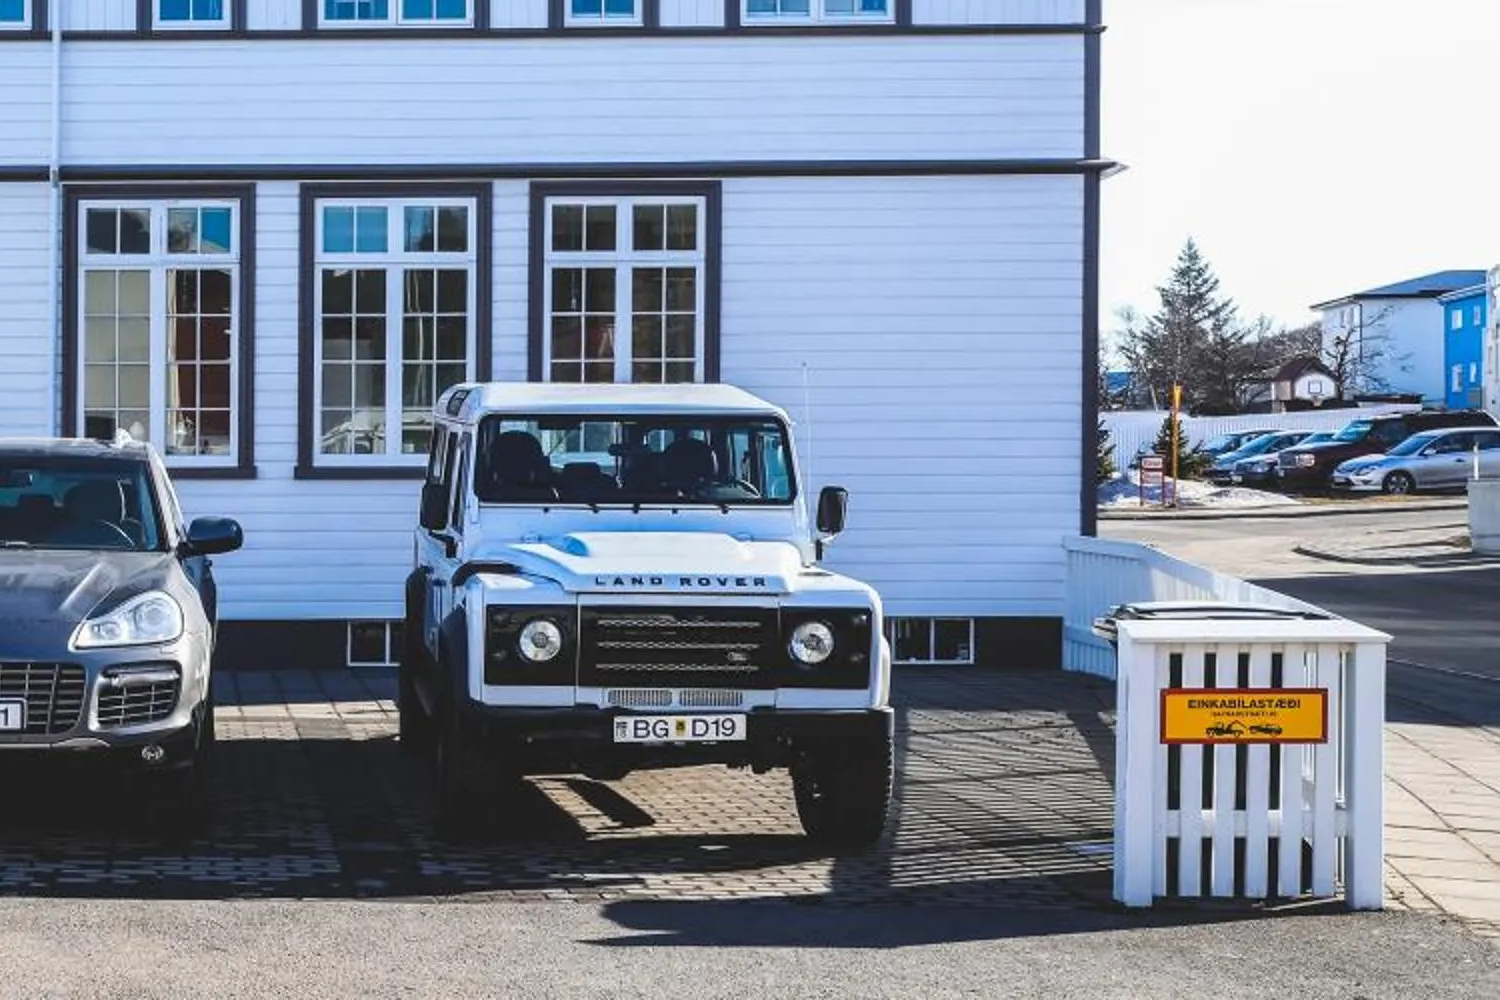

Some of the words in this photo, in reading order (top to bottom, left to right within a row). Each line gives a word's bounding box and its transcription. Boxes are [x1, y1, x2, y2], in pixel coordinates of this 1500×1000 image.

[595, 576, 663, 587] LAND
[679, 576, 767, 587] ROVER
[633, 719, 670, 739] BG
[691, 718, 737, 738] D19
